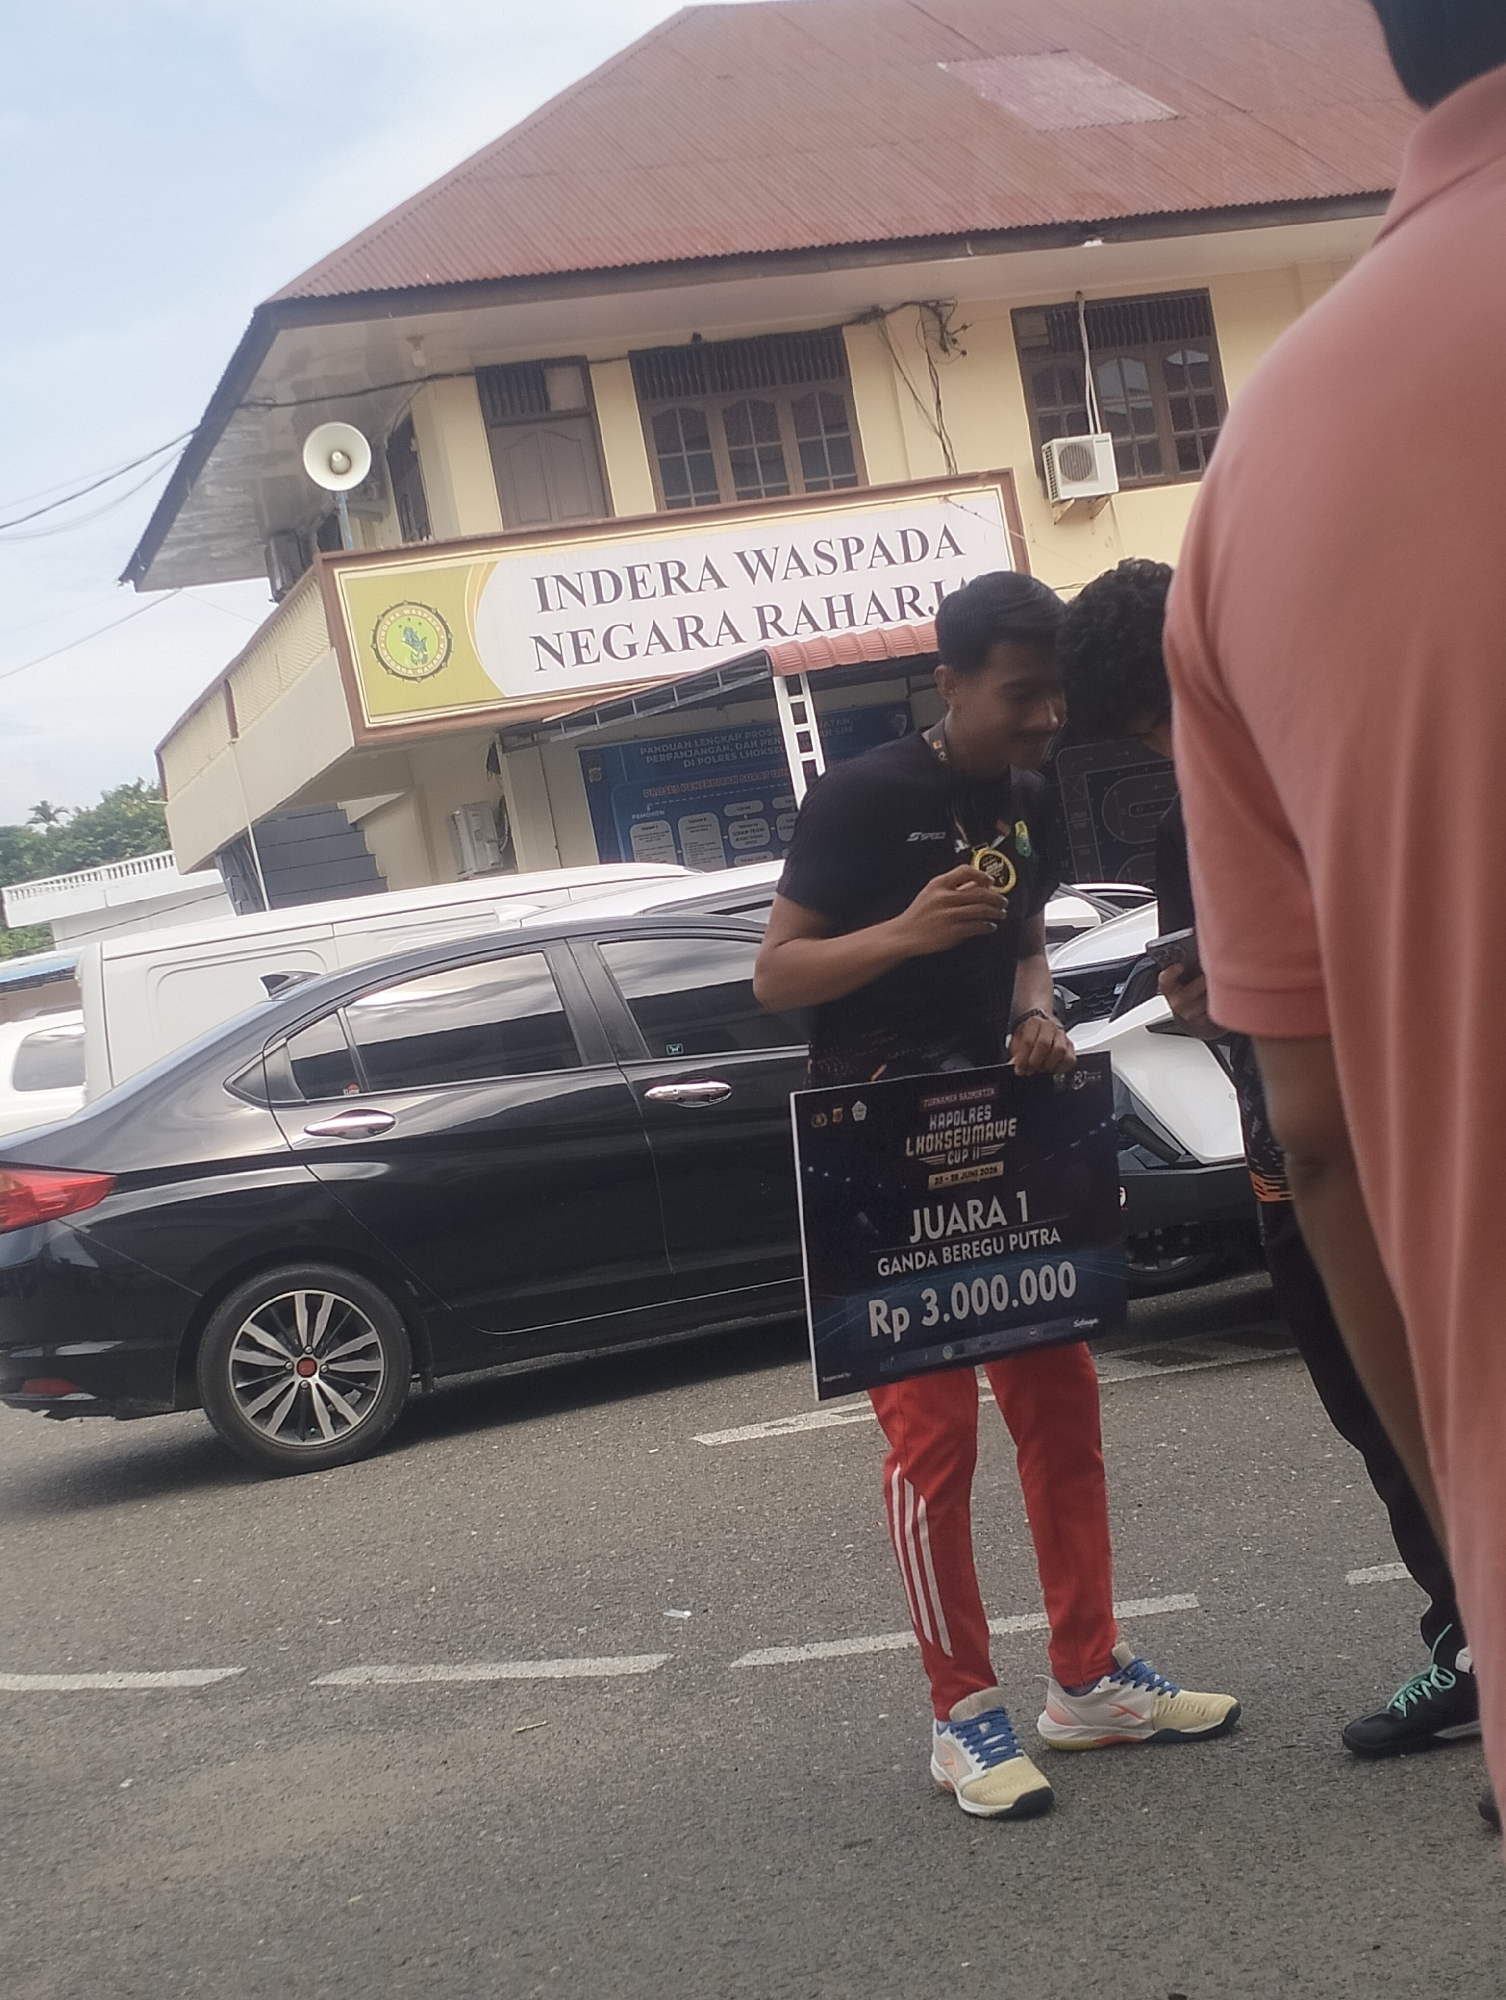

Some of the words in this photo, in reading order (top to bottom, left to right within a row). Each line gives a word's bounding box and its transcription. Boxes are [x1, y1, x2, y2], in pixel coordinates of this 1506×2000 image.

[531, 555, 731, 614] INDERA
[733, 523, 966, 586] WASPADA
[403, 609, 440, 631] WASPADA
[530, 608, 748, 673] NEGARA
[752, 576, 968, 641] RAHARJ
[640, 741, 692, 756] PANDUAN
[694, 733, 742, 748] LENGKAP
[745, 727, 782, 740] PROSE
[736, 739, 758, 752] DAN
[683, 758, 695, 769] DI
[698, 752, 738, 767] POLRES
[929, 1104, 992, 1131] KAPOLRES
[906, 1117, 1018, 1157] LHOKSEUMAWE
[947, 1148, 969, 1165] CUP
[909, 1195, 1008, 1244] JUARA
[1016, 1190, 1029, 1223] 1
[877, 1250, 938, 1277] GANDA
[942, 1236, 1005, 1264] BEREGU
[1009, 1226, 1062, 1252] PUTRA
[868, 1299, 910, 1343] Rp
[920, 1260, 1077, 1327] 3.000.000
